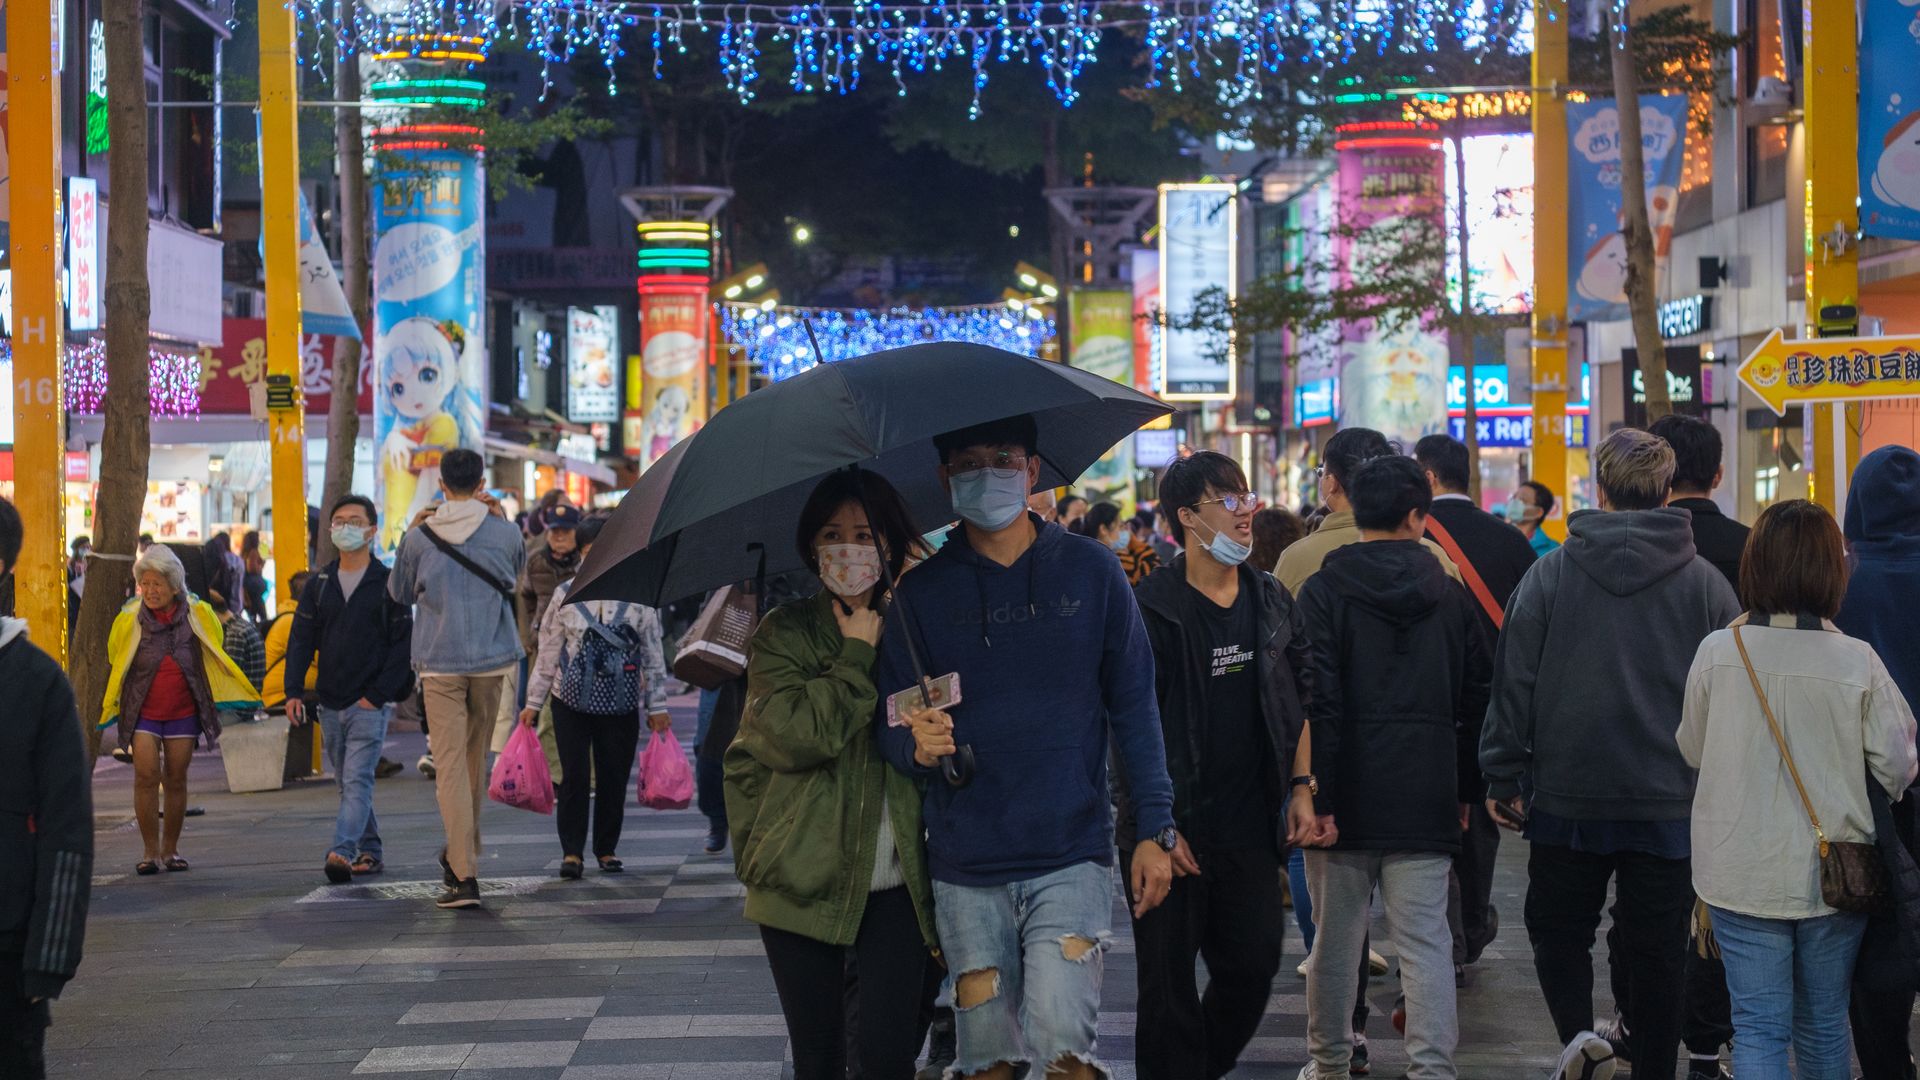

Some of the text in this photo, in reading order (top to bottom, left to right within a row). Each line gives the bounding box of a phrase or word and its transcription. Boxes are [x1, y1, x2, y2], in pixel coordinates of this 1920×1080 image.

[21, 315, 46, 345] H
[1786, 356, 1800, 385] 日式
[18, 377, 54, 406] 16
[1452, 417, 1491, 442] Tx
[1539, 415, 1564, 436] 13
[1211, 650, 1255, 668] A CREATIVE
[1211, 665, 1227, 677] LIFE
